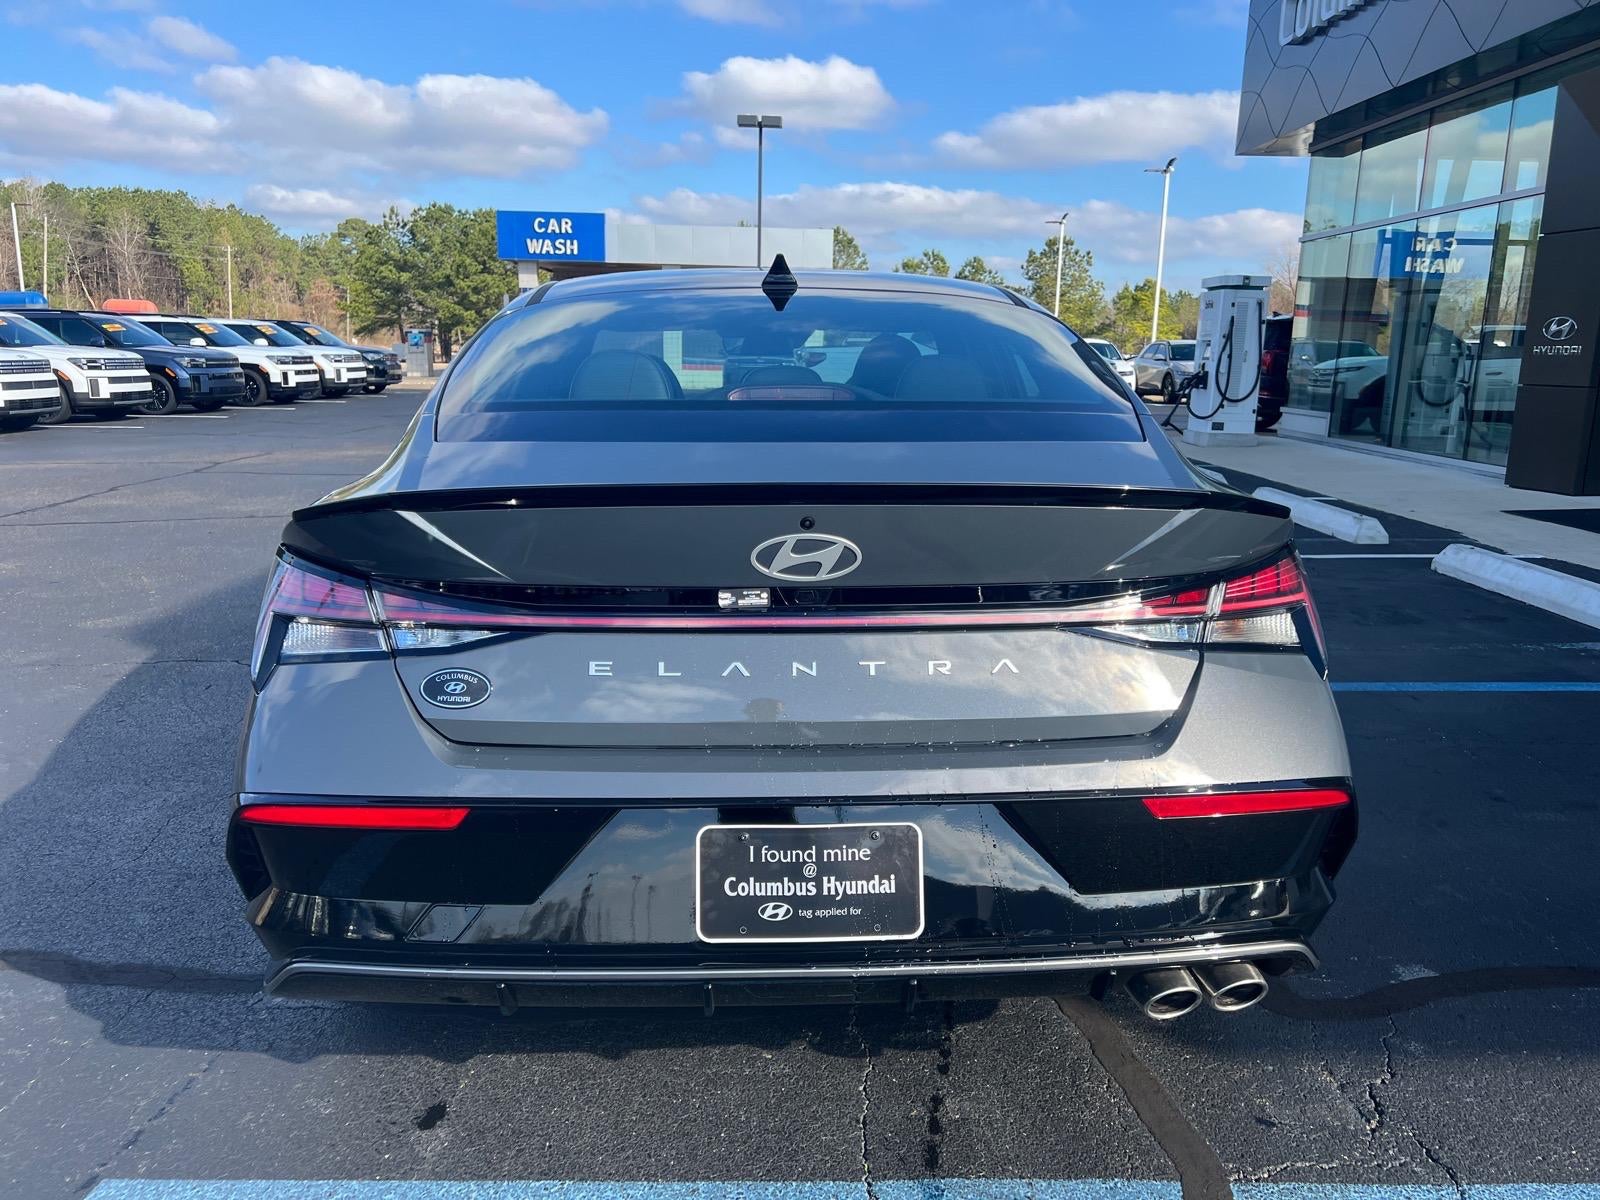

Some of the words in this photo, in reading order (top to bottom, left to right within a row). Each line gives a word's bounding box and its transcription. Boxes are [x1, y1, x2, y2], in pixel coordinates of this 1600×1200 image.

[533, 217, 573, 234] CAR
[525, 238, 578, 255] WASH
[1532, 345, 1582, 355] HYUNDAI
[588, 658, 1019, 678] ELANTRA
[435, 673, 479, 684] COLUMBUS
[437, 695, 471, 703] HYUNDAI
[749, 845, 754, 863] I
[761, 845, 816, 863] found
[823, 844, 871, 862] mine
[803, 863, 817, 878] @
[724, 876, 817, 897] Columbus
[822, 874, 896, 900] Hyundai
[798, 908, 813, 918] tag
[815, 907, 848, 918] applied
[849, 906, 862, 915] for
